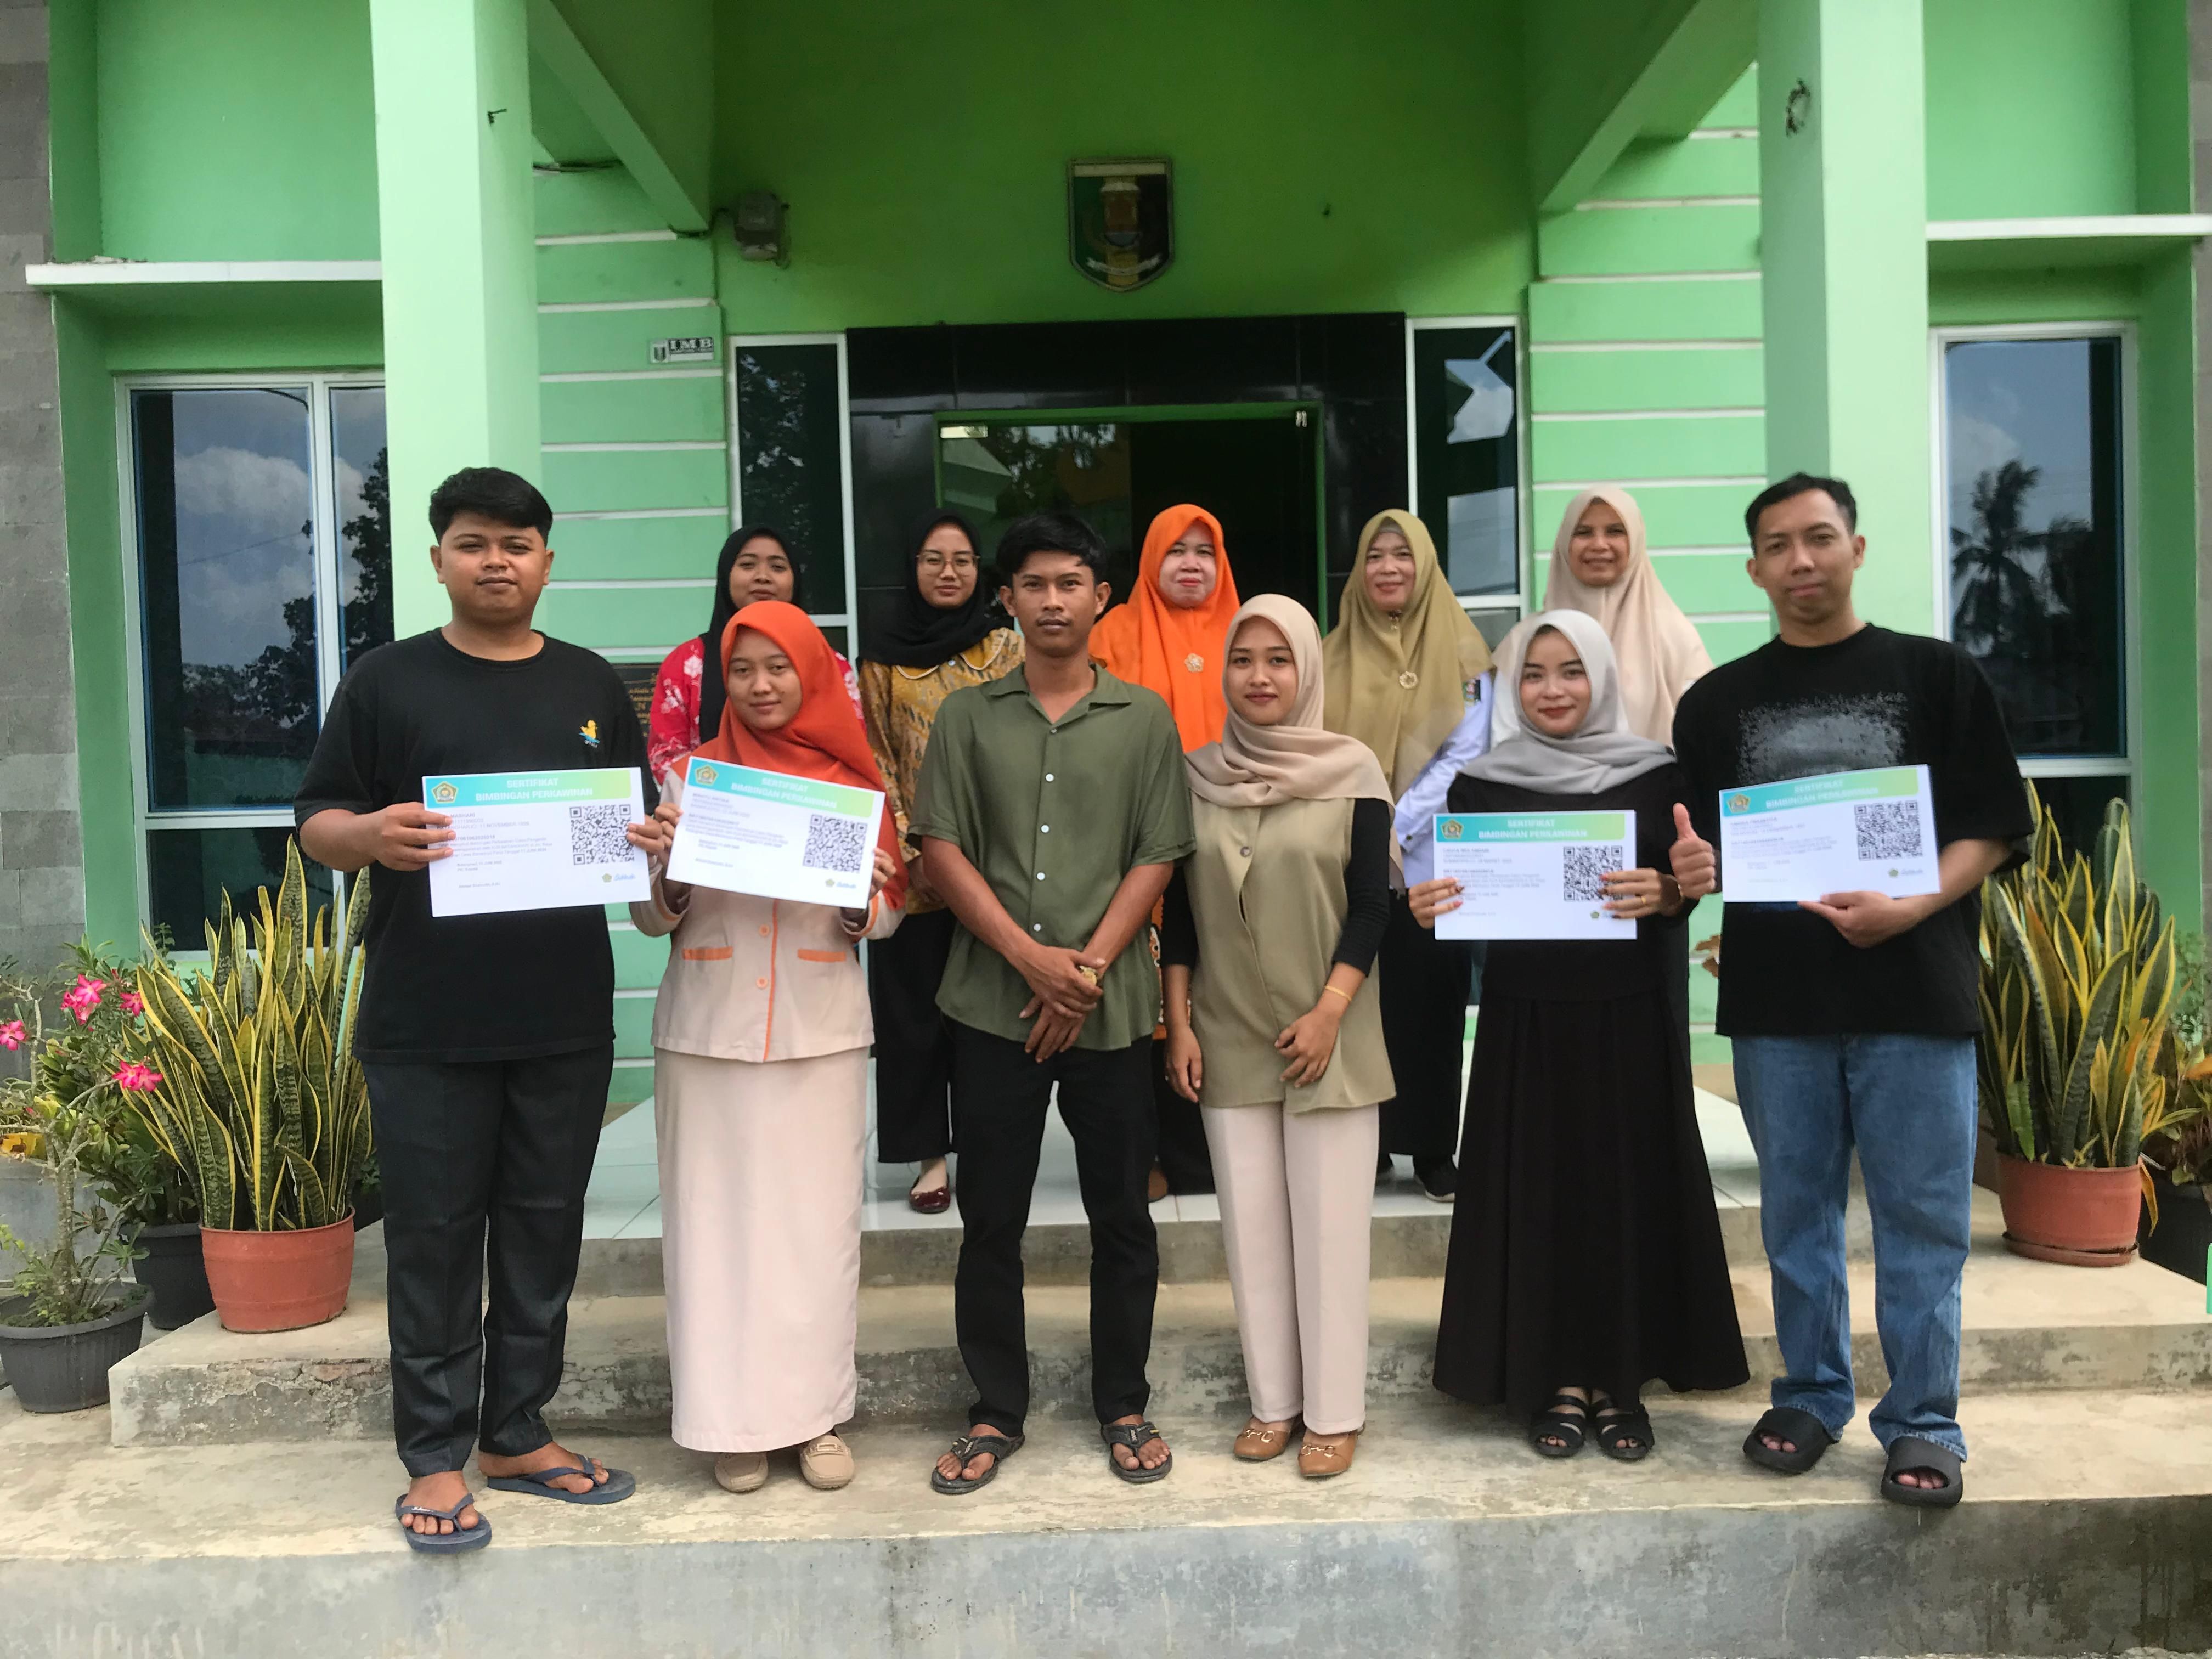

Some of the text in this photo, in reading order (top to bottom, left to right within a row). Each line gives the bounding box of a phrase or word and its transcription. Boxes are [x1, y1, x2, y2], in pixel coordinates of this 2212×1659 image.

[507, 778, 558, 788] SERTIFIKAT
[762, 777, 808, 792] SERTIFIKAT
[476, 788, 593, 802] BIMBINGAN PERKAWINAN
[731, 782, 837, 808] BIMBINGAN PERKAWINAN
[1765, 794, 1816, 809] BIMBINGAN
[1507, 819, 1555, 828] SERTIFIKAT
[1479, 830, 1588, 839] BIMBINGAN PERKAWINAN
